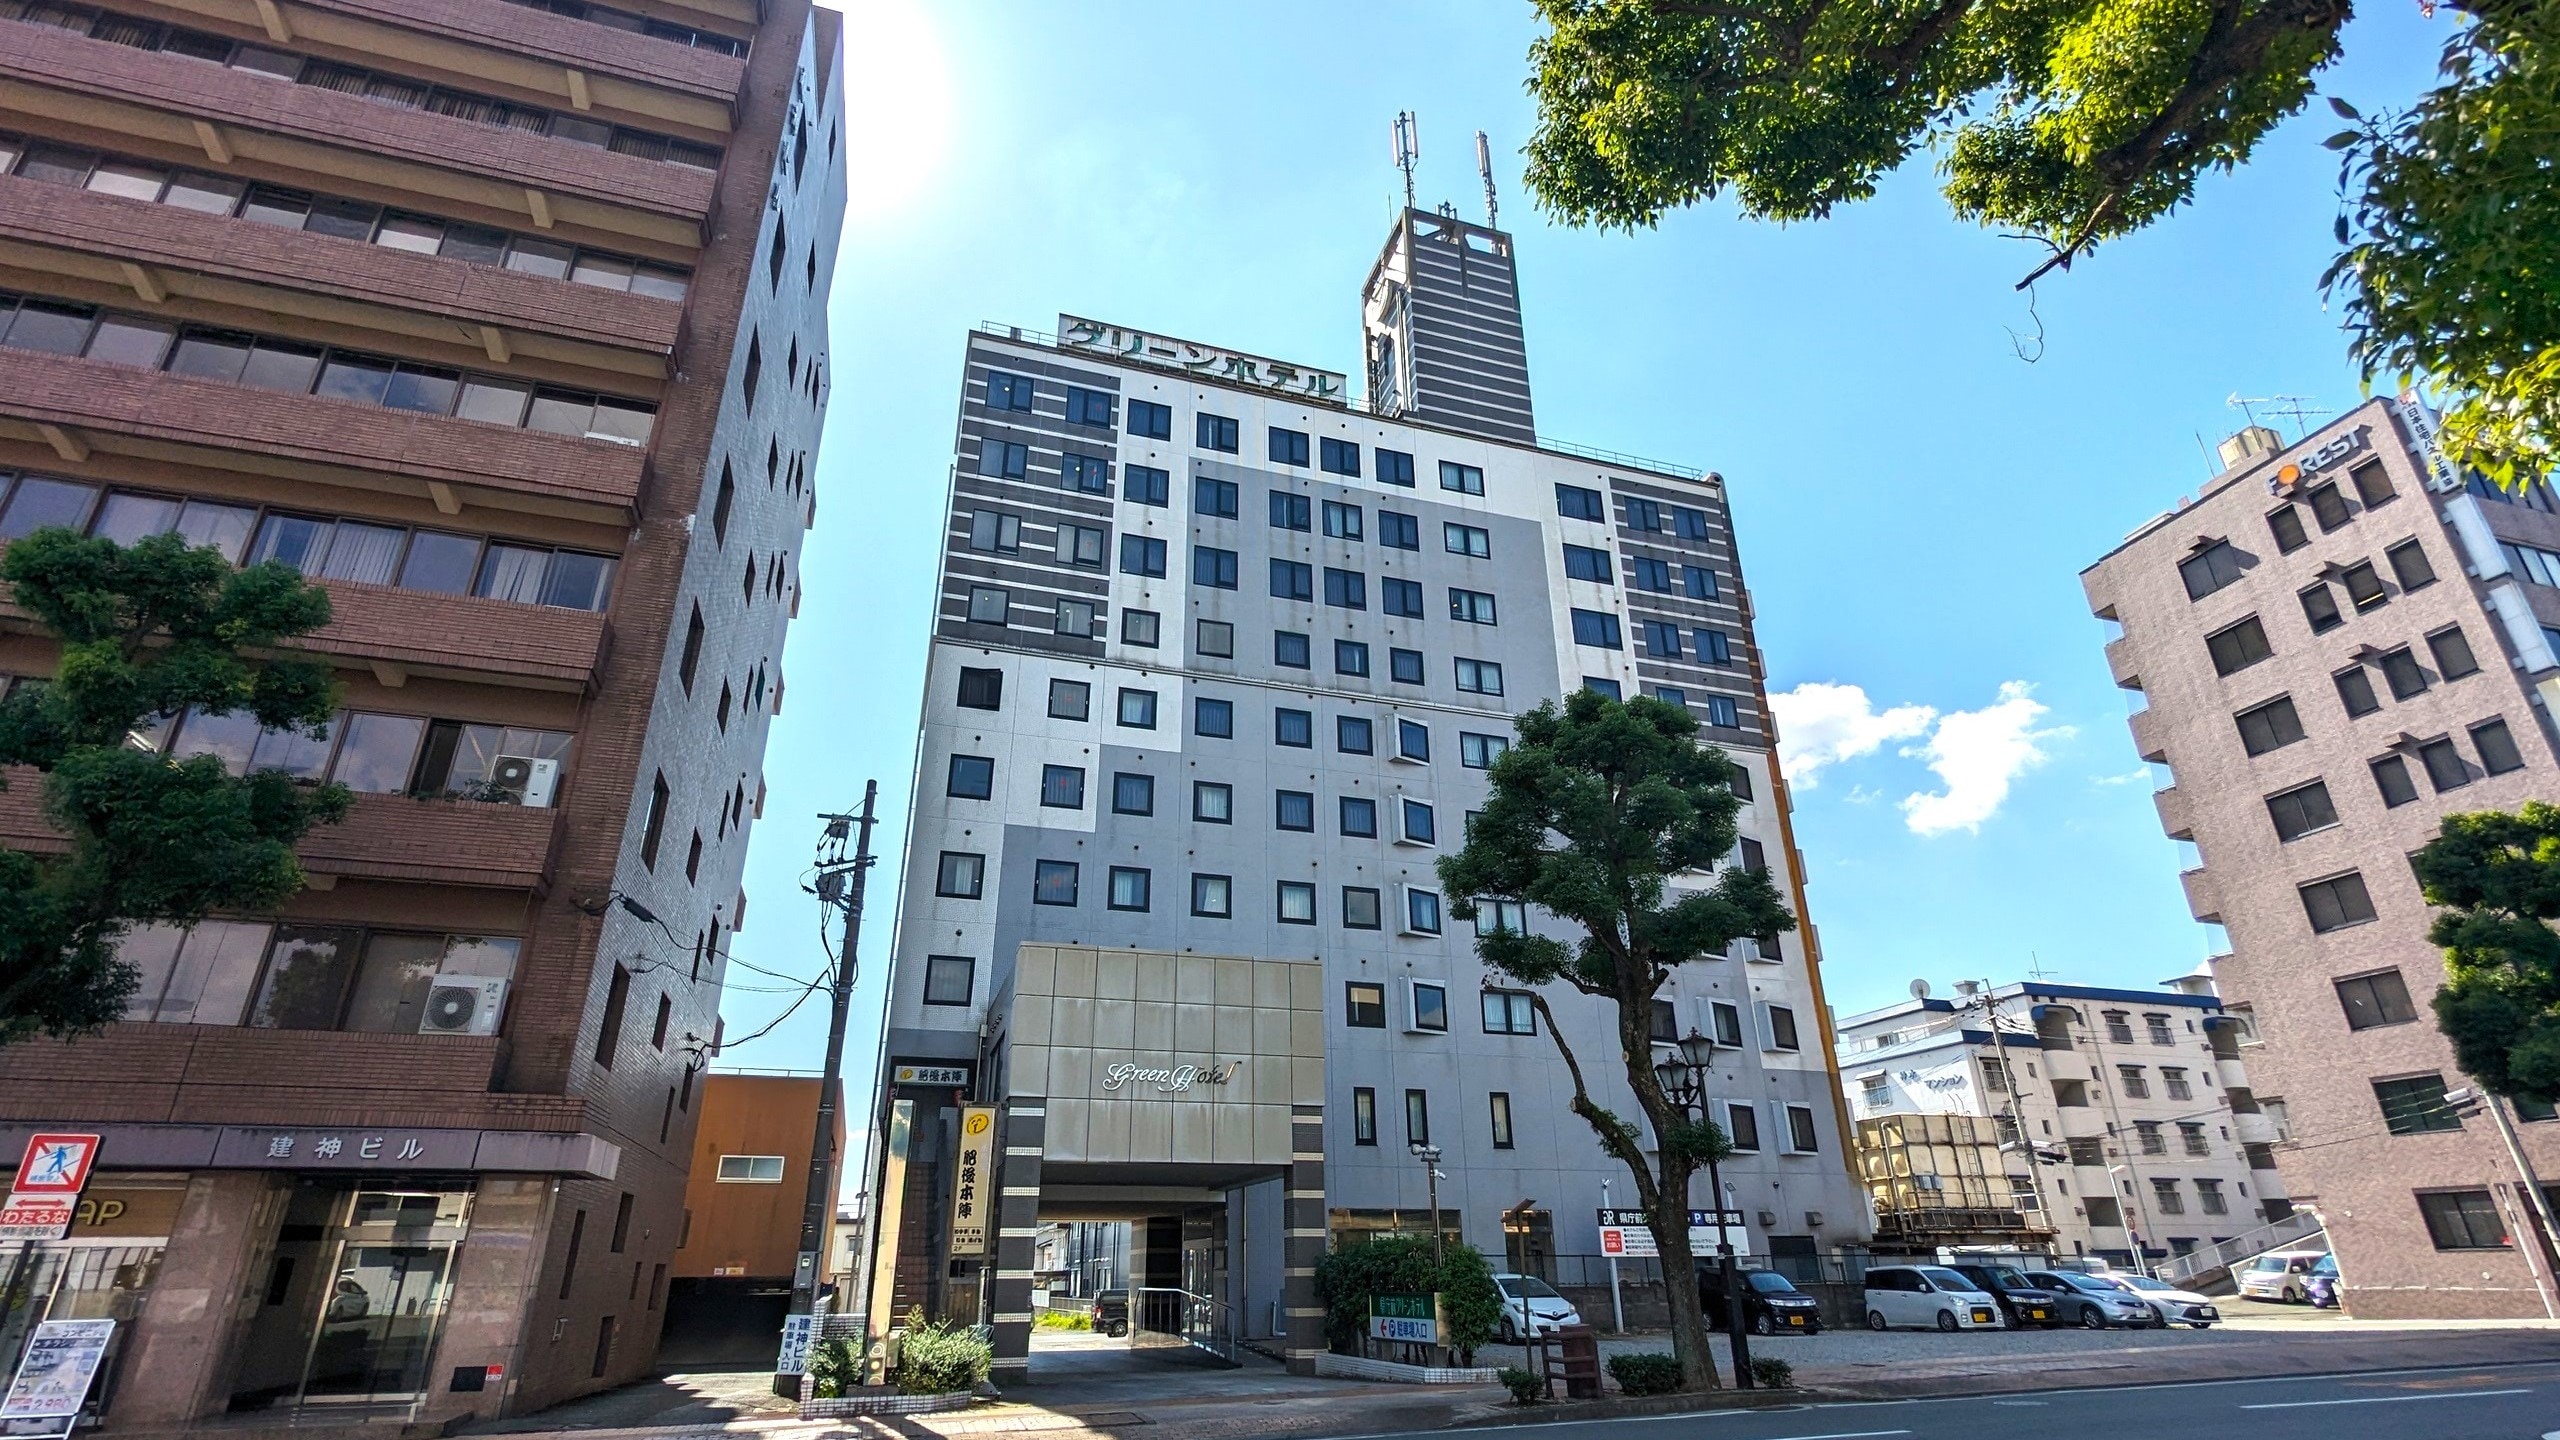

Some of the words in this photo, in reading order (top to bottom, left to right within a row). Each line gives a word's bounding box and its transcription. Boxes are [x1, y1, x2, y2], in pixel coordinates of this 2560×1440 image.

[1067, 322, 1339, 398] グリーンホテル
[1102, 1063, 1171, 1091] Green
[1157, 1060, 1243, 1093] Hotel
[266, 1136, 424, 1161] 建神ビル
[957, 1149, 977, 1220] 肥後本陣
[2, 1211, 68, 1224] わたるな
[791, 1317, 811, 1372] 建神ビル
[1397, 1321, 1428, 1339] 駐車場入口
